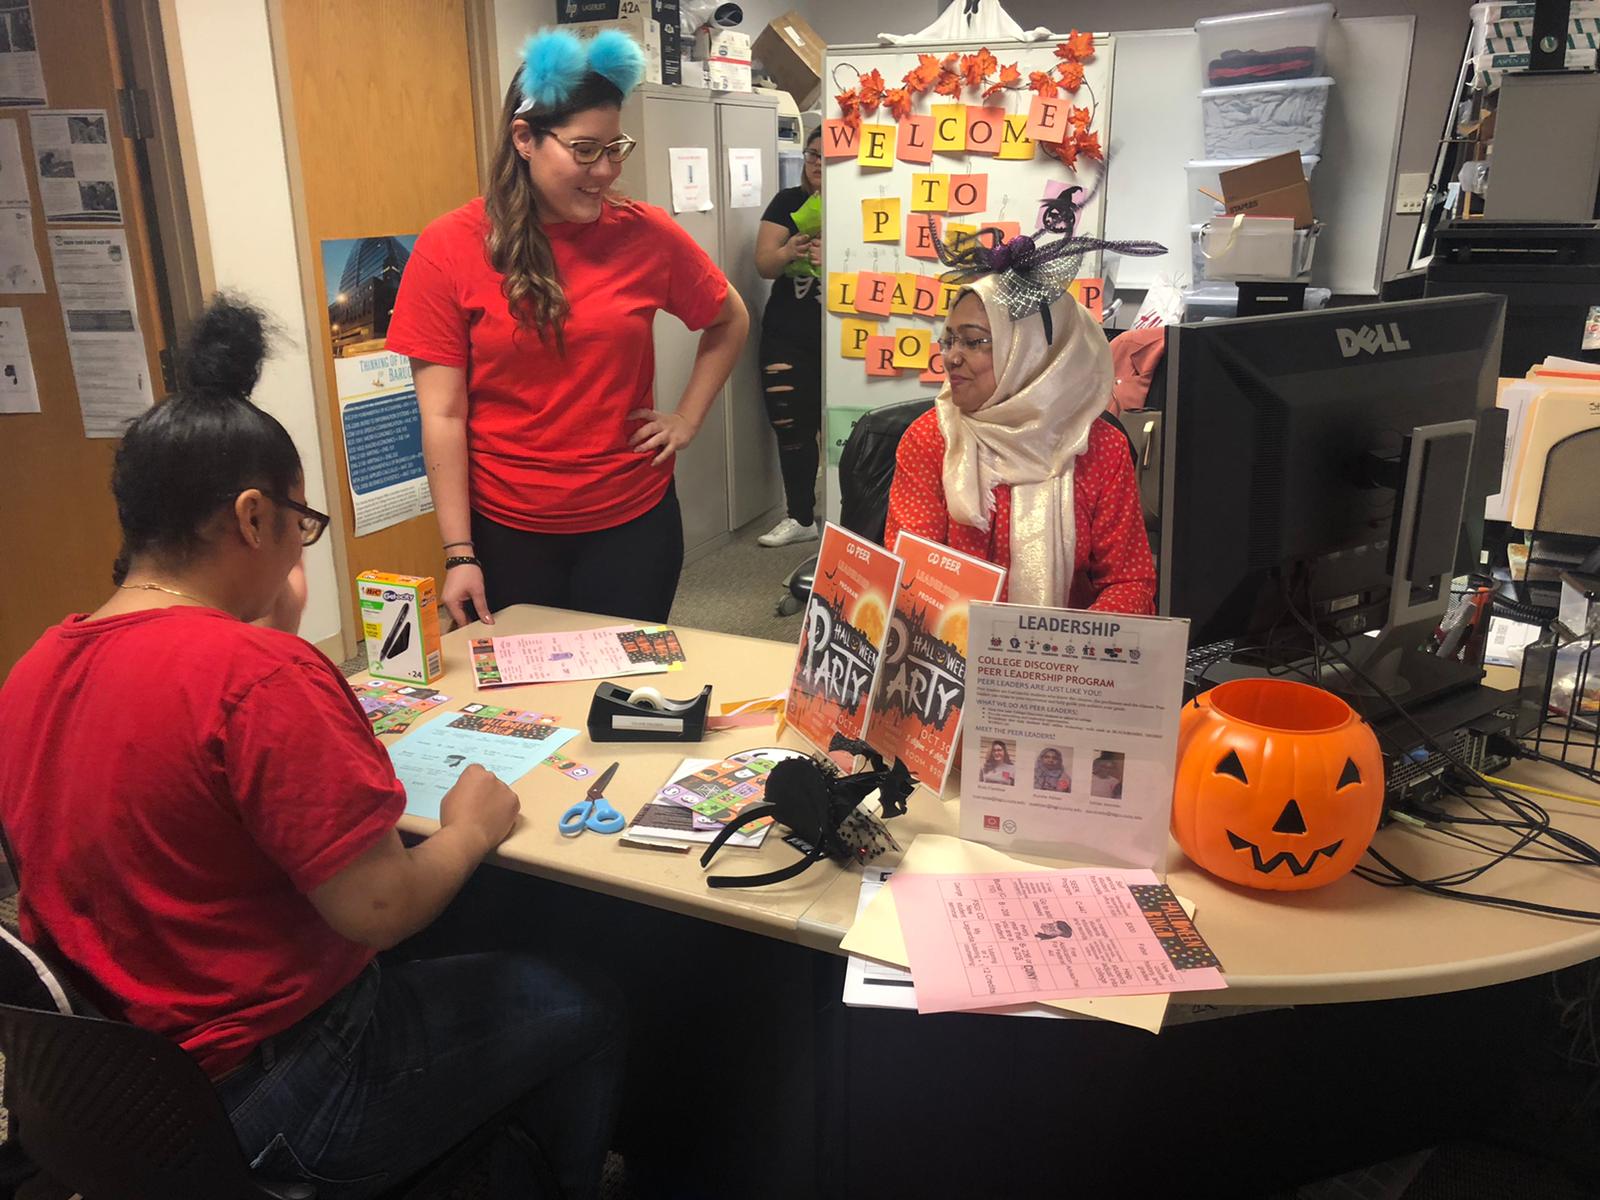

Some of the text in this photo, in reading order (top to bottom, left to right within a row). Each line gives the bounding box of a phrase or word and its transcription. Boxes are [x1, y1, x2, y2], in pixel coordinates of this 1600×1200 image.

[621, 2, 640, 14] 42A
[920, 179, 978, 206] TO
[1336, 322, 1410, 358] DELL
[855, 546, 870, 565] PEER
[940, 556, 961, 575] PEER
[918, 591, 944, 611] PROGRAM
[1018, 615, 1120, 637] LEADERSHIP
[803, 598, 873, 706] PARTY
[914, 635, 966, 678] HALLOWEE
[978, 655, 1021, 667] COLLEGE
[1024, 660, 1079, 673] DISCOVERY
[978, 666, 1115, 688] PEER LEADERSHIP PROGRAM
[997, 679, 1029, 689] LEADERS
[1030, 683, 1044, 691] ARE
[1046, 684, 1065, 693] JUST
[1065, 687, 1081, 695] LIKE
[921, 729, 939, 746] OCT
[1007, 728, 1024, 737] PEER
[1143, 911, 1176, 937] BINGO
[1157, 900, 1204, 947] HALLOWEEN
